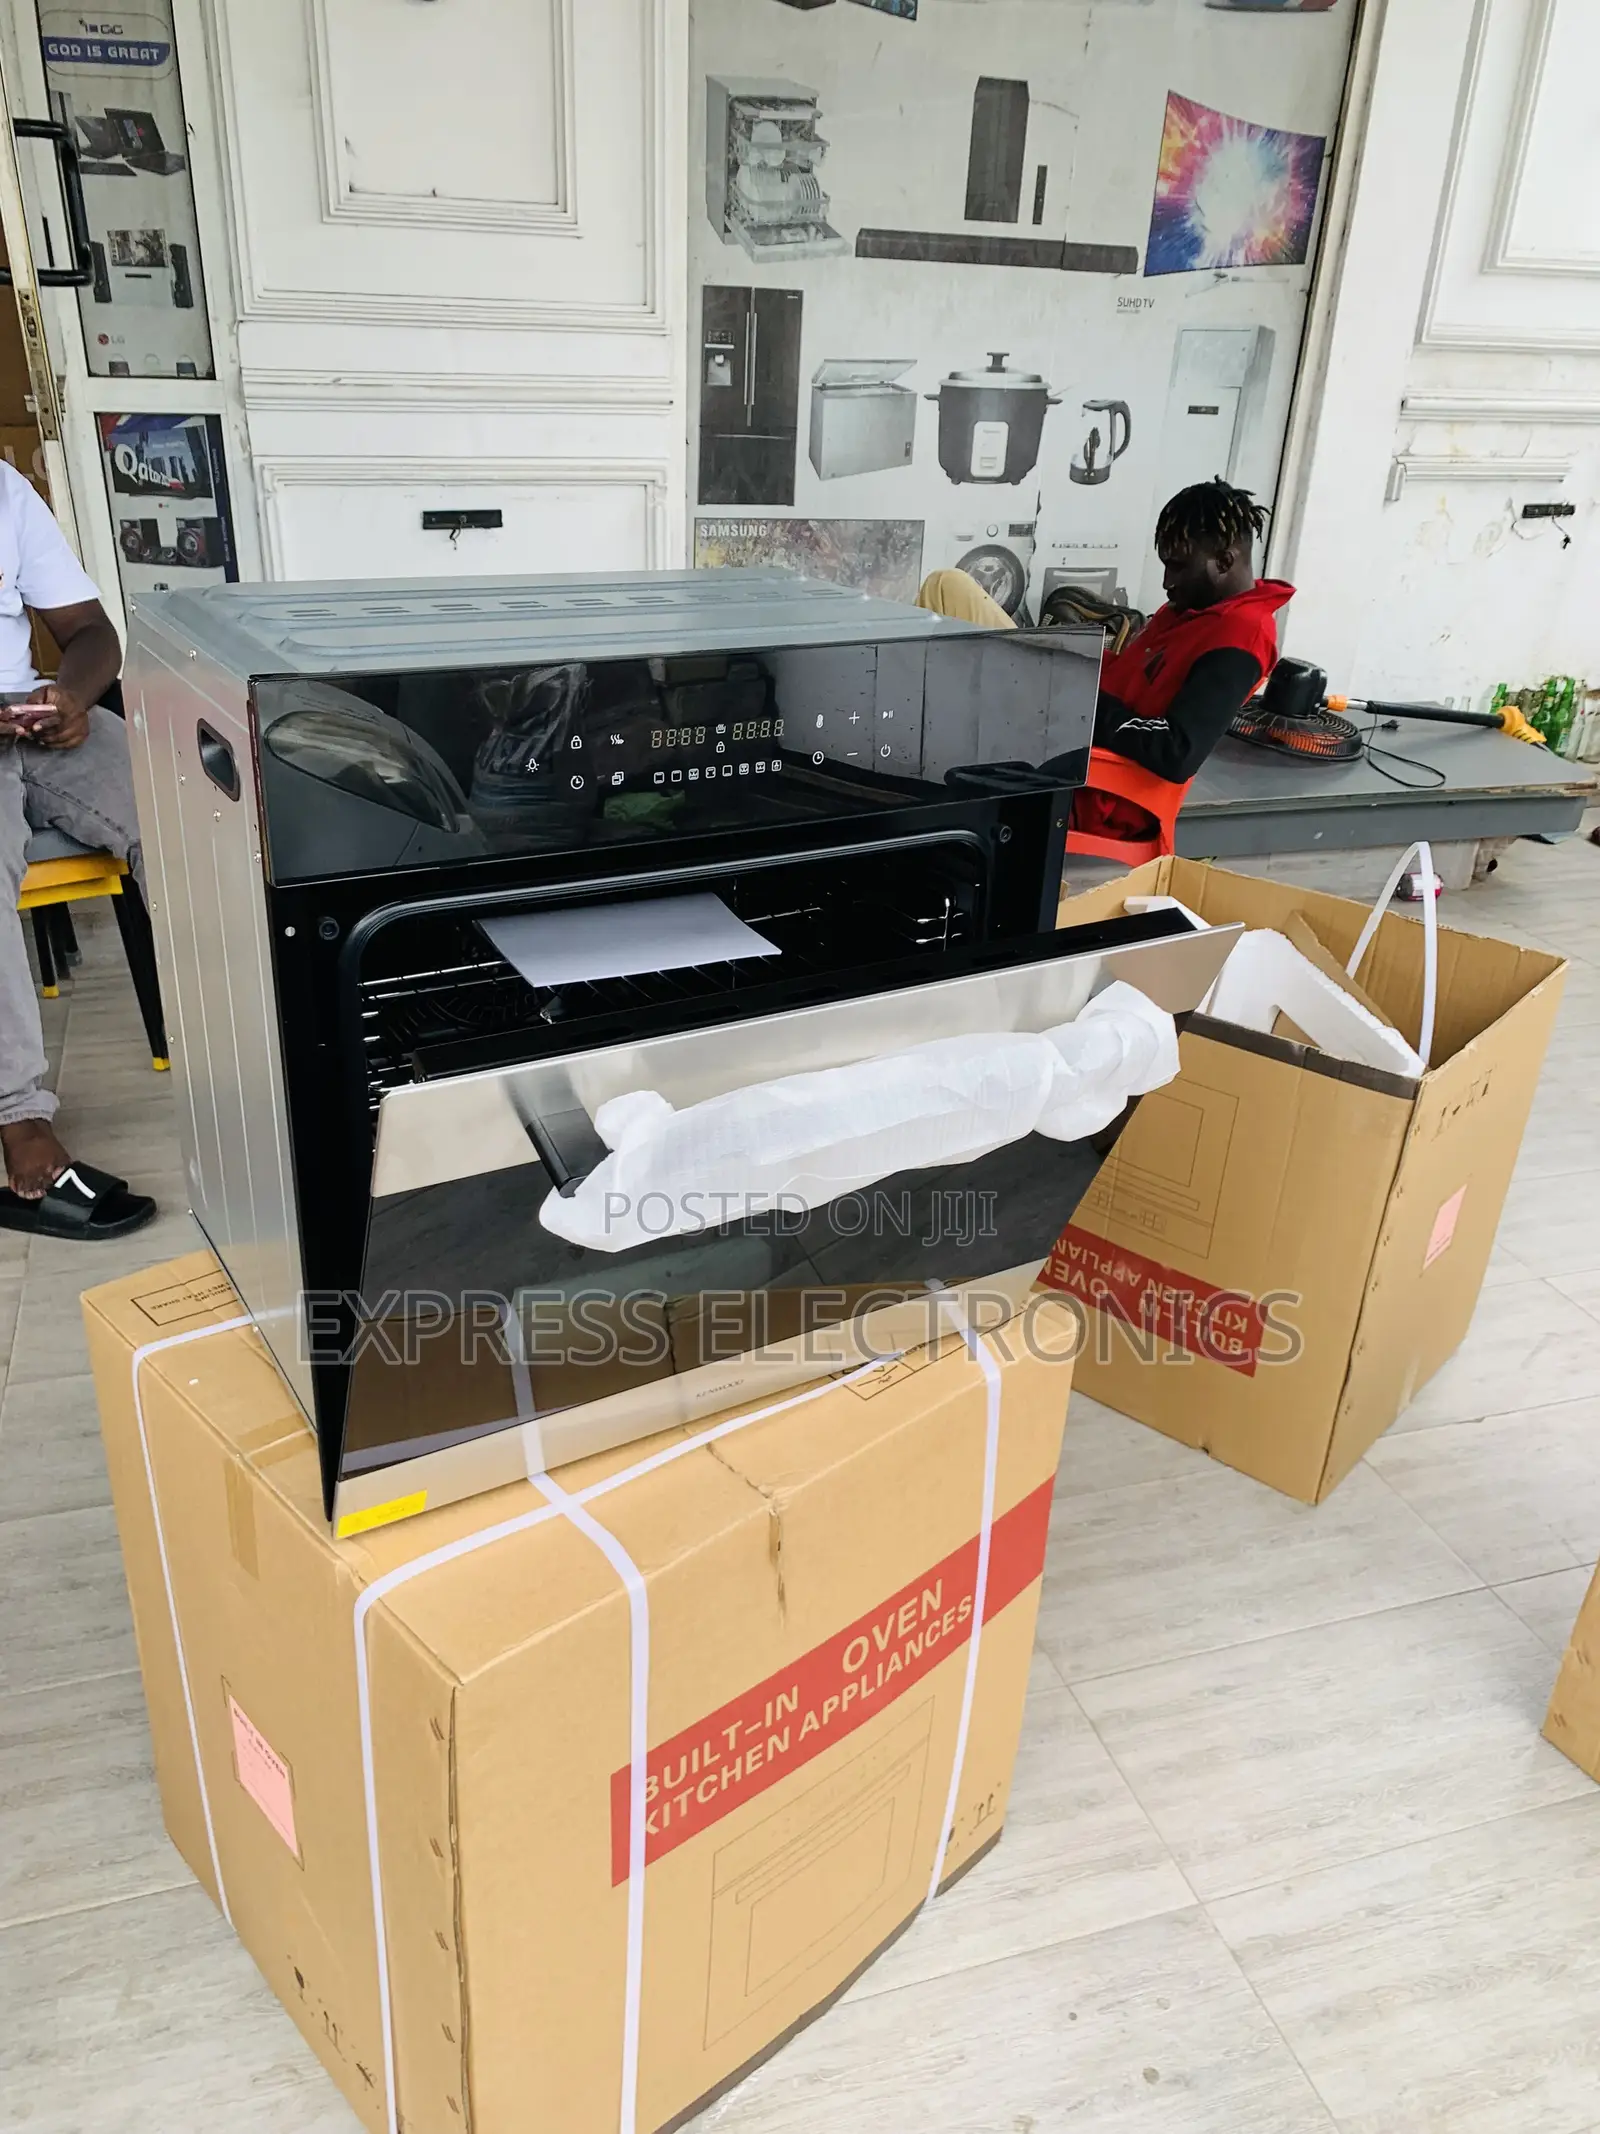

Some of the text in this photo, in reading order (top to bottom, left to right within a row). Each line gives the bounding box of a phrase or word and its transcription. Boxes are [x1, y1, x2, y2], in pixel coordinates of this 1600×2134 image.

[48, 43, 160, 60] GOD IS GREAT
[1117, 296, 1156, 309] SUHD TV
[700, 523, 768, 537] SAMSUNG
[1053, 1238, 1142, 1287] APPLIAN
[841, 1578, 943, 1674] OVEN
[798, 1595, 973, 1741] APPLIANCES
